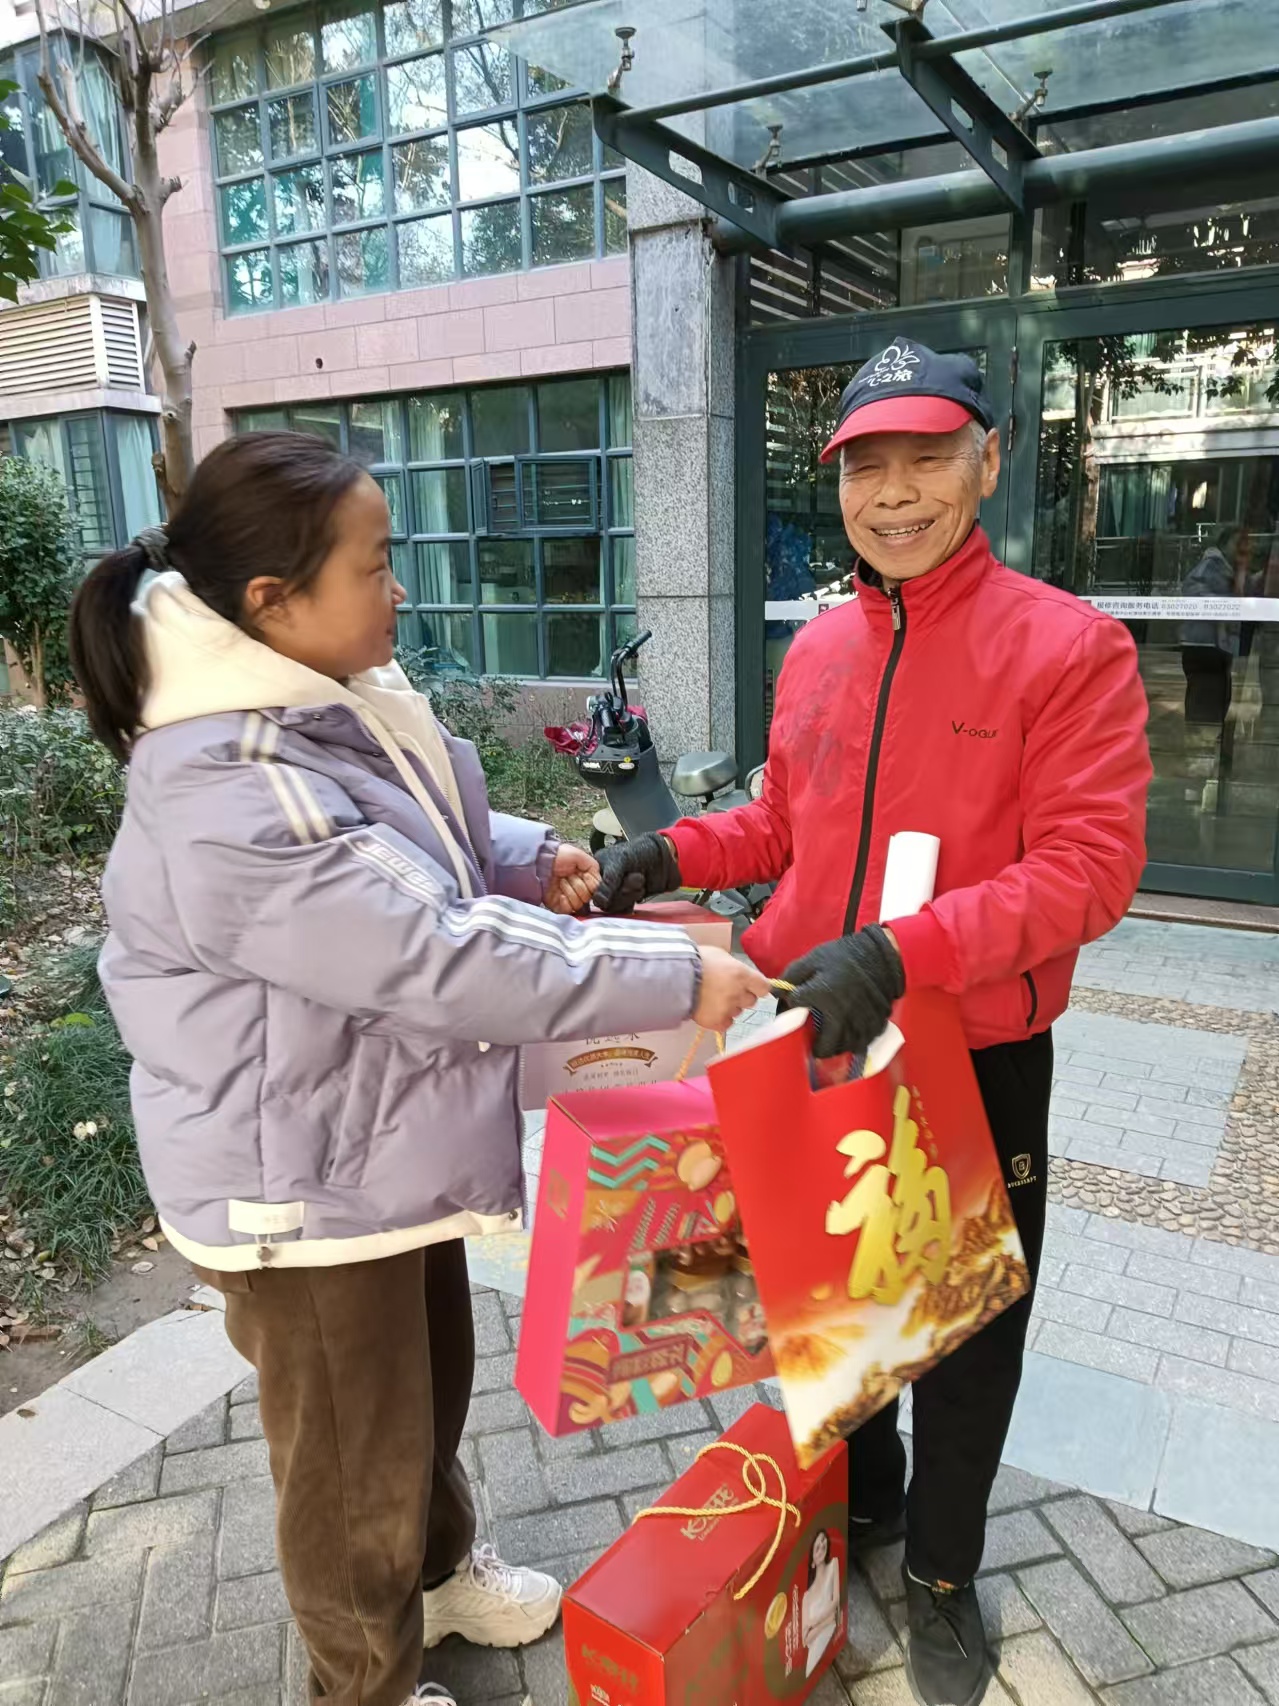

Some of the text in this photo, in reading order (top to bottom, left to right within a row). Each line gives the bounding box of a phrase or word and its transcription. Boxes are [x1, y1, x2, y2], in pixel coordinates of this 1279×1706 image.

[868, 369, 913, 387] 心之旅
[825, 1084, 950, 1306] 福
